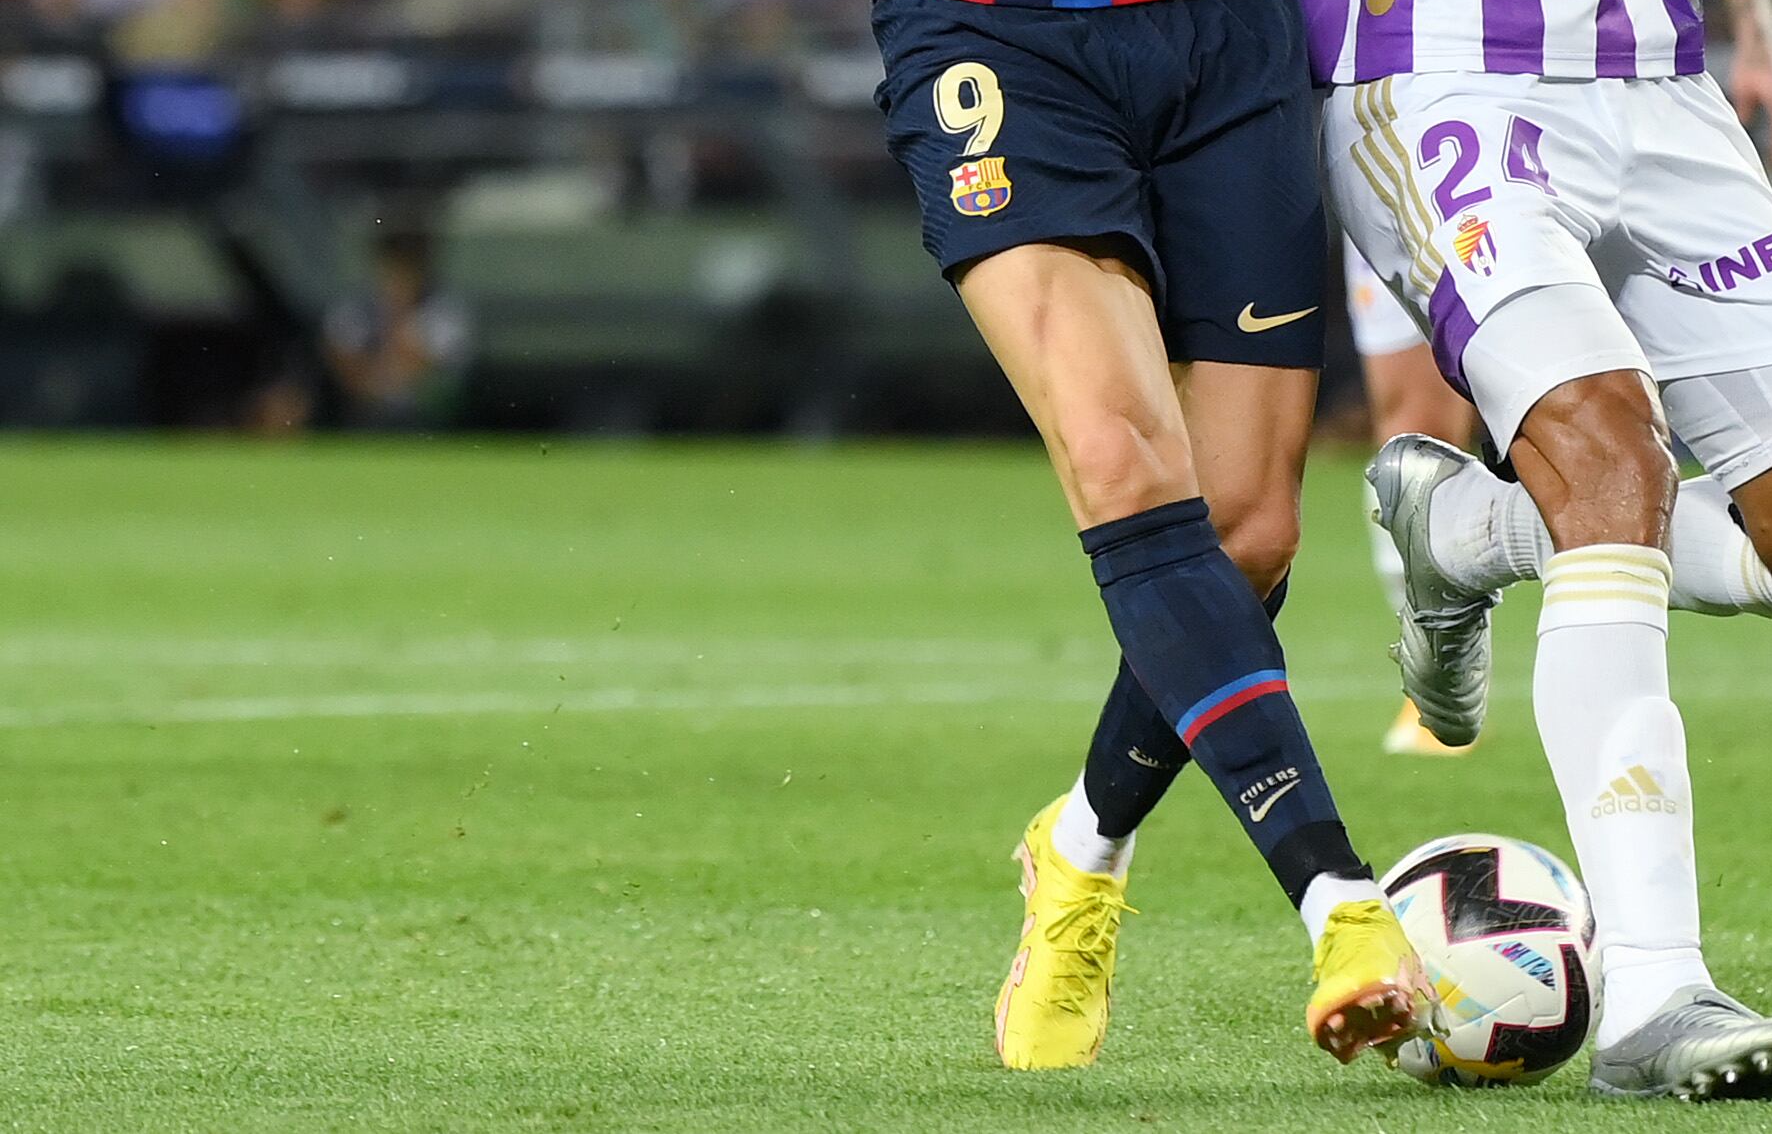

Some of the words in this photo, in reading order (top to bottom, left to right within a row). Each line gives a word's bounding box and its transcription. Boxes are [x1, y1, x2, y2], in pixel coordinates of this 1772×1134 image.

[933, 62, 1004, 156] 9
[1417, 114, 1558, 226] 24
[1239, 767, 1299, 804] CULERS
[1591, 795, 1677, 819] adidas
